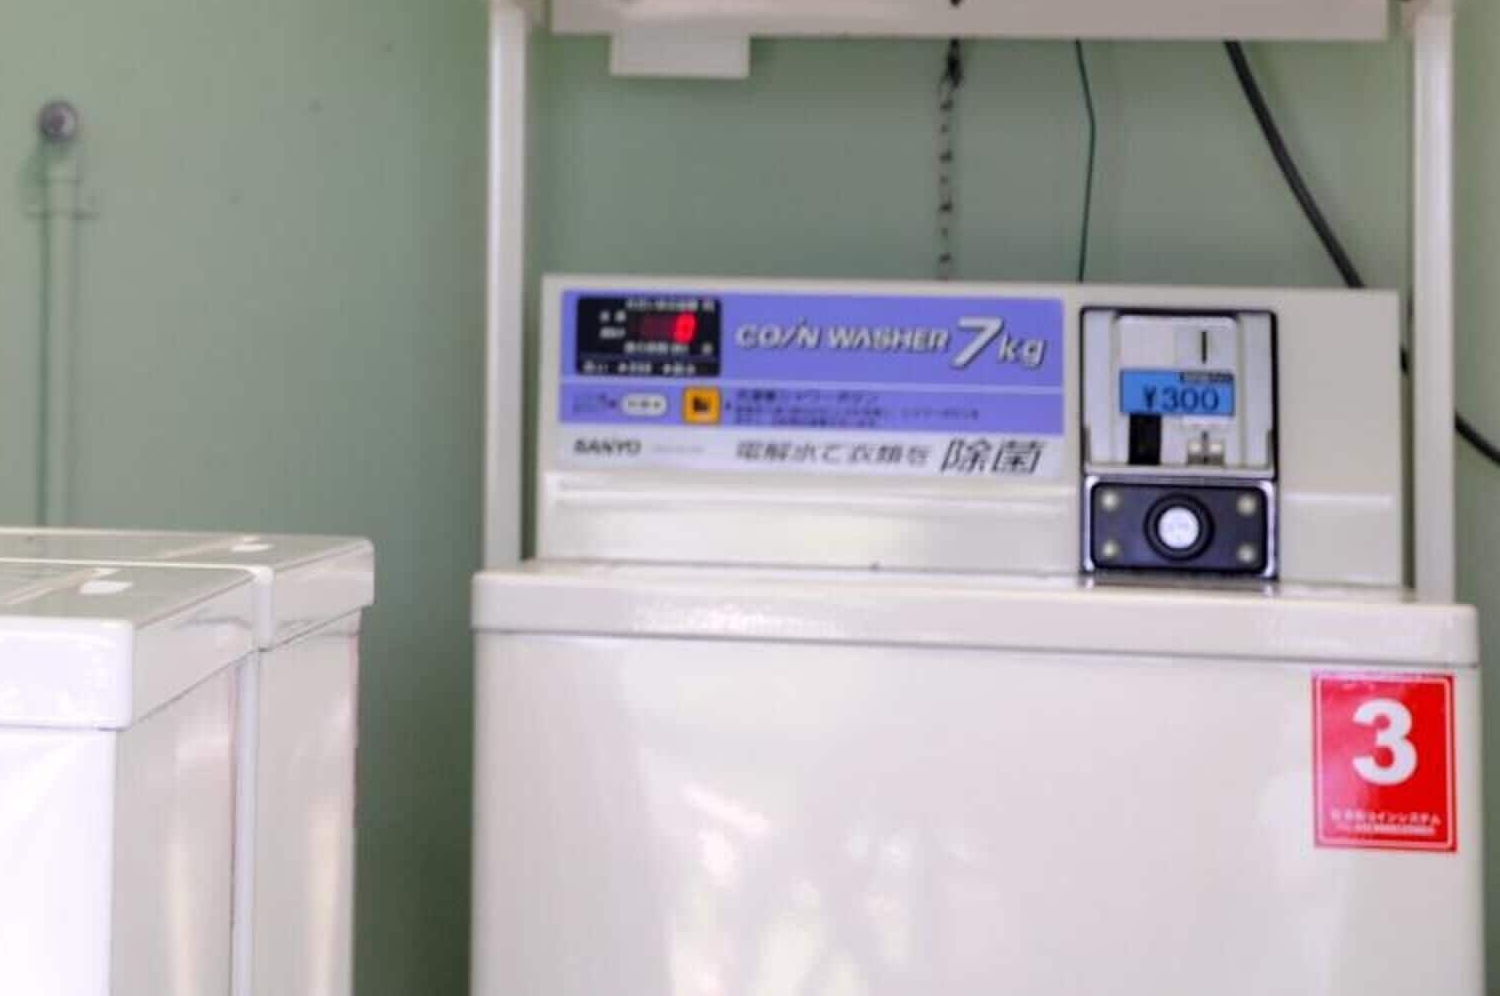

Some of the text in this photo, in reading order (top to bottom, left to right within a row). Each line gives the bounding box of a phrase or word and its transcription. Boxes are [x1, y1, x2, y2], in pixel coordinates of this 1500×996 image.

[828, 324, 949, 354] WASHER
[1141, 385, 1221, 414] ¥300
[573, 438, 642, 456] SANYO
[940, 437, 1046, 476] 除菌
[1351, 697, 1419, 786] 3
